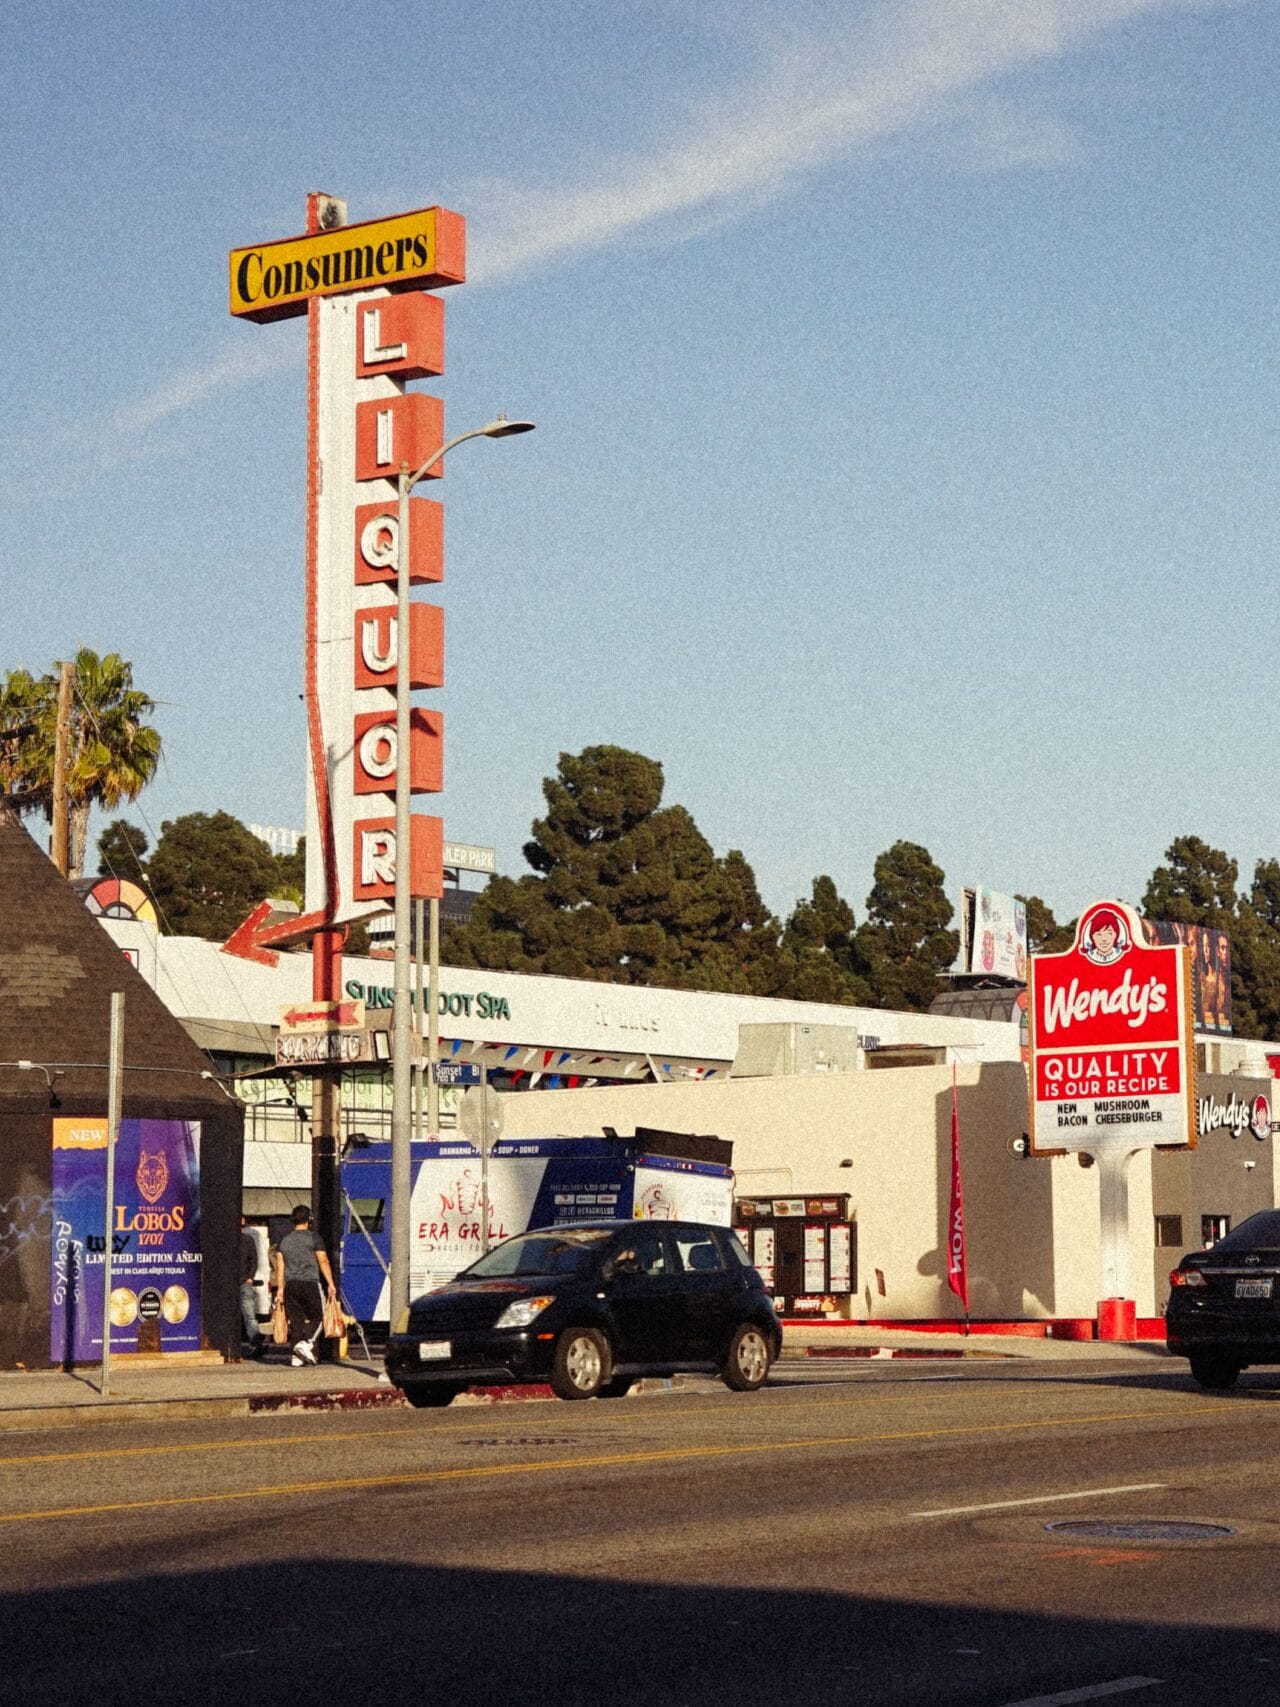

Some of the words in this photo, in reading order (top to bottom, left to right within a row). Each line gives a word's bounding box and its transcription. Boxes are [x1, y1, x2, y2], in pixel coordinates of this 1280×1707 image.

[237, 231, 428, 303] Consumers
[359, 308, 407, 885] LIQUOR
[468, 848, 495, 868] PARK
[476, 992, 512, 1021] SPA
[1043, 968, 1168, 1034] Wendy's
[436, 1064, 462, 1077] Sunset
[1044, 1051, 1168, 1082] QUALITY
[1045, 1083, 1060, 1097] IS
[1065, 1080, 1101, 1096] OUR
[1106, 1076, 1169, 1094] RECIPE
[1057, 1103, 1077, 1114] NEW
[1094, 1099, 1150, 1112] MUSHROOM
[1199, 1092, 1250, 1137] Wendy's
[1057, 1115, 1088, 1127] BACON
[1095, 1111, 1162, 1125] CHEESEBURGER
[69, 1128, 105, 1142] NEW
[115, 1205, 185, 1231] LOBOS
[138, 1233, 165, 1246] 1707
[418, 1222, 450, 1240] ERA
[458, 1222, 509, 1239] GRLL
[86, 1253, 133, 1264] LIMTED
[136, 1253, 173, 1263] EDITION
[176, 1250, 203, 1263] AÑEJO
[132, 1267, 148, 1275] CLASS
[165, 1267, 185, 1275] TEQUILA
